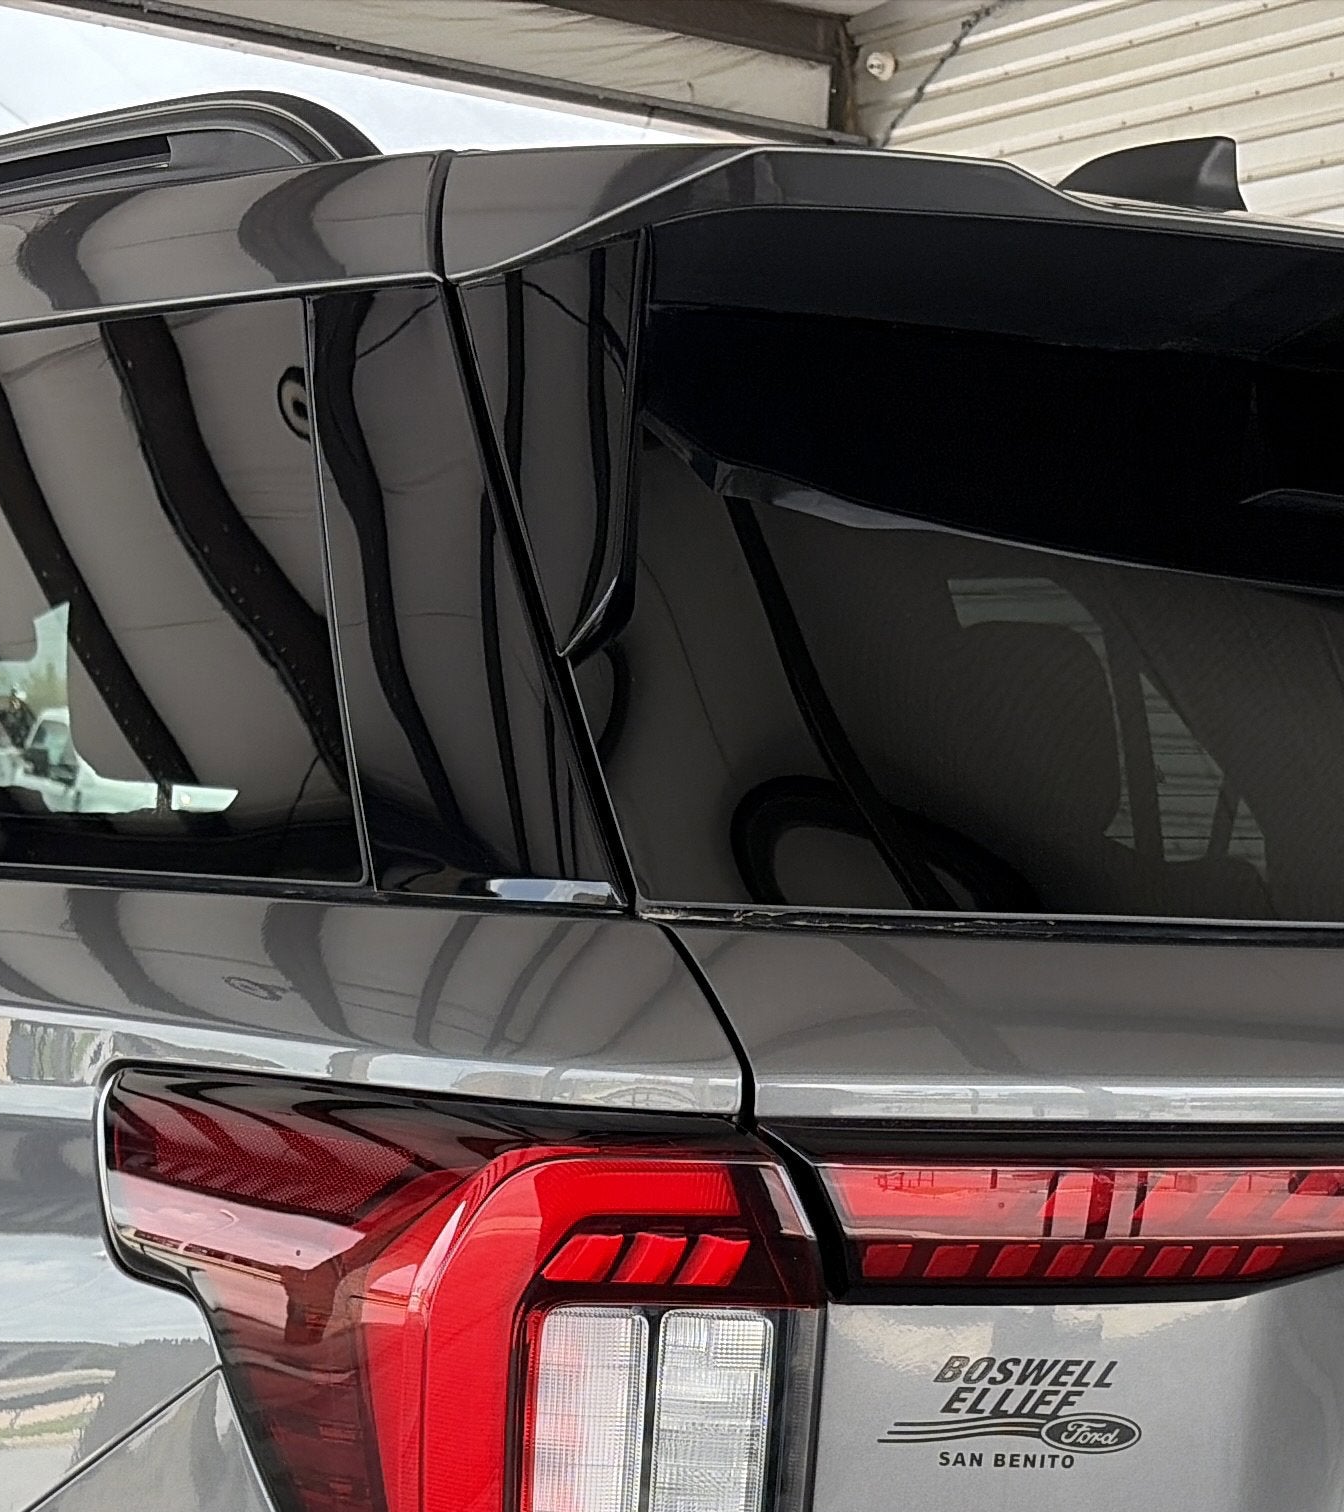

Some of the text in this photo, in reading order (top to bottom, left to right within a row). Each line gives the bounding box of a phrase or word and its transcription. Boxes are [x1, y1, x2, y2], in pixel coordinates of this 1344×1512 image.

[932, 1355, 1119, 1389] BOSWELL
[939, 1386, 1085, 1417] ELLIFF
[1060, 1421, 1119, 1446] Ford
[938, 1451, 1076, 1470] SAN BENITO
